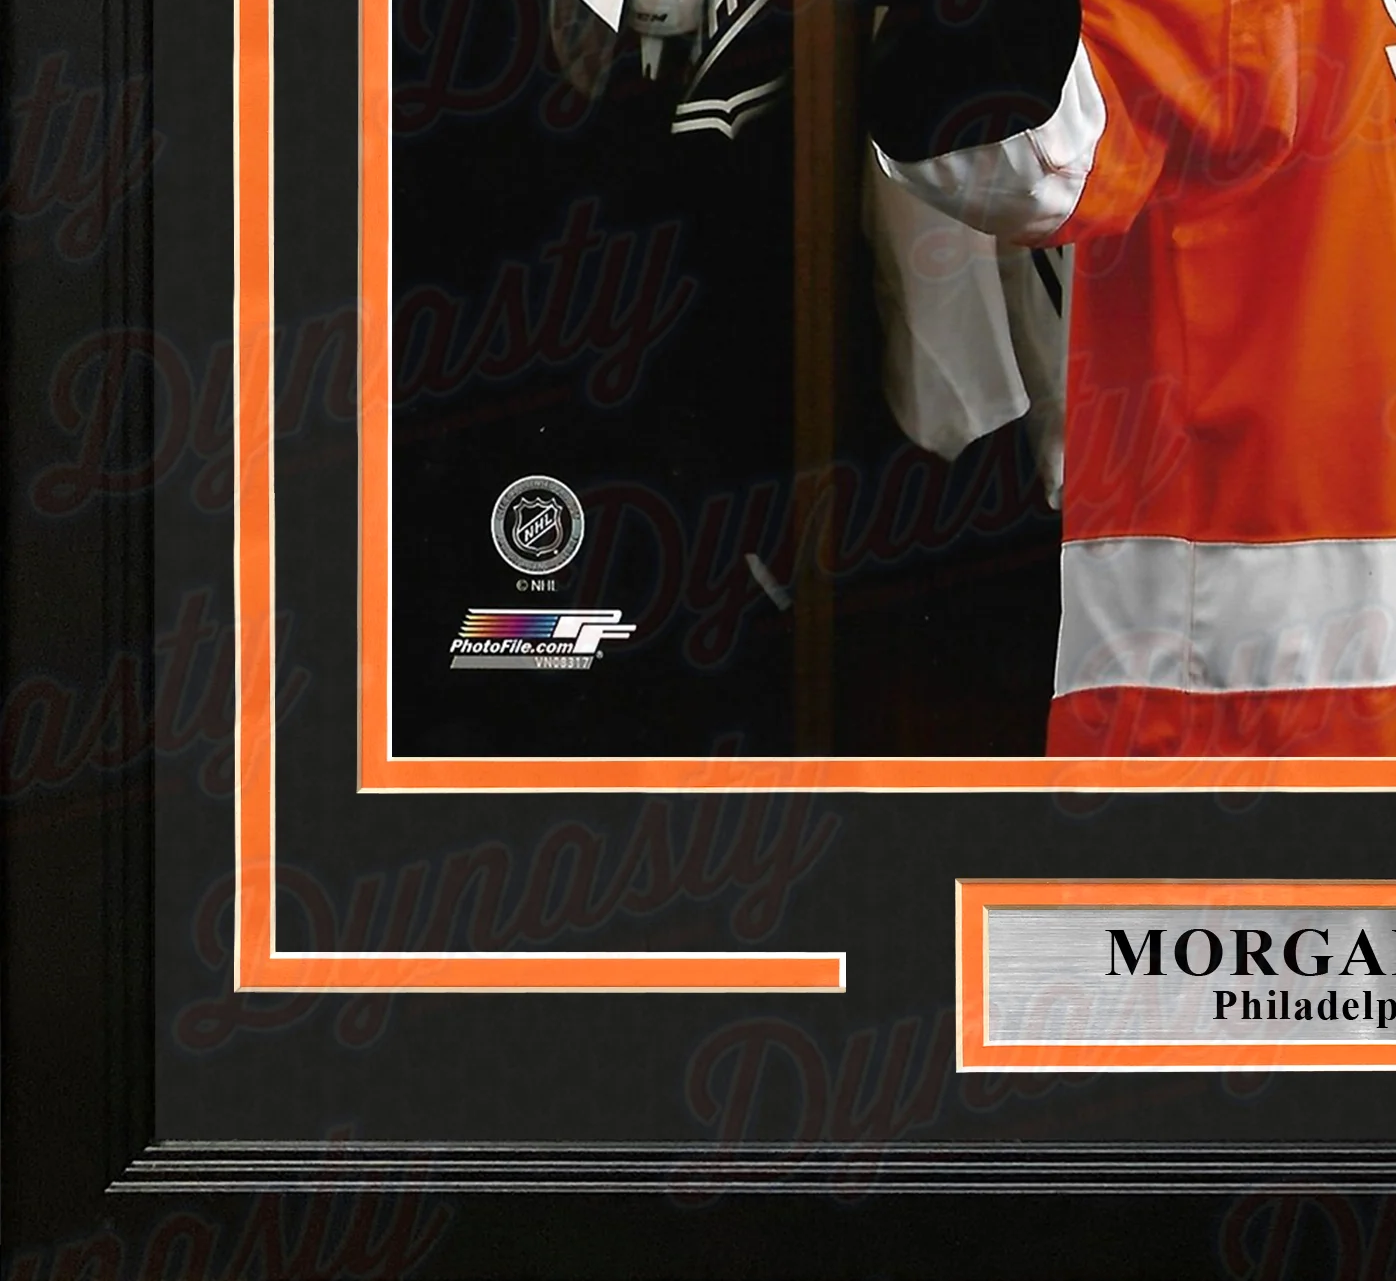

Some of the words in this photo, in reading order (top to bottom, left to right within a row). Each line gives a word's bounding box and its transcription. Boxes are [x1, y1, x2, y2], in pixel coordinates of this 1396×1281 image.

[524, 513, 553, 542] NHL
[531, 579, 557, 592] NHL
[450, 638, 574, 654] PhotoFile.com
